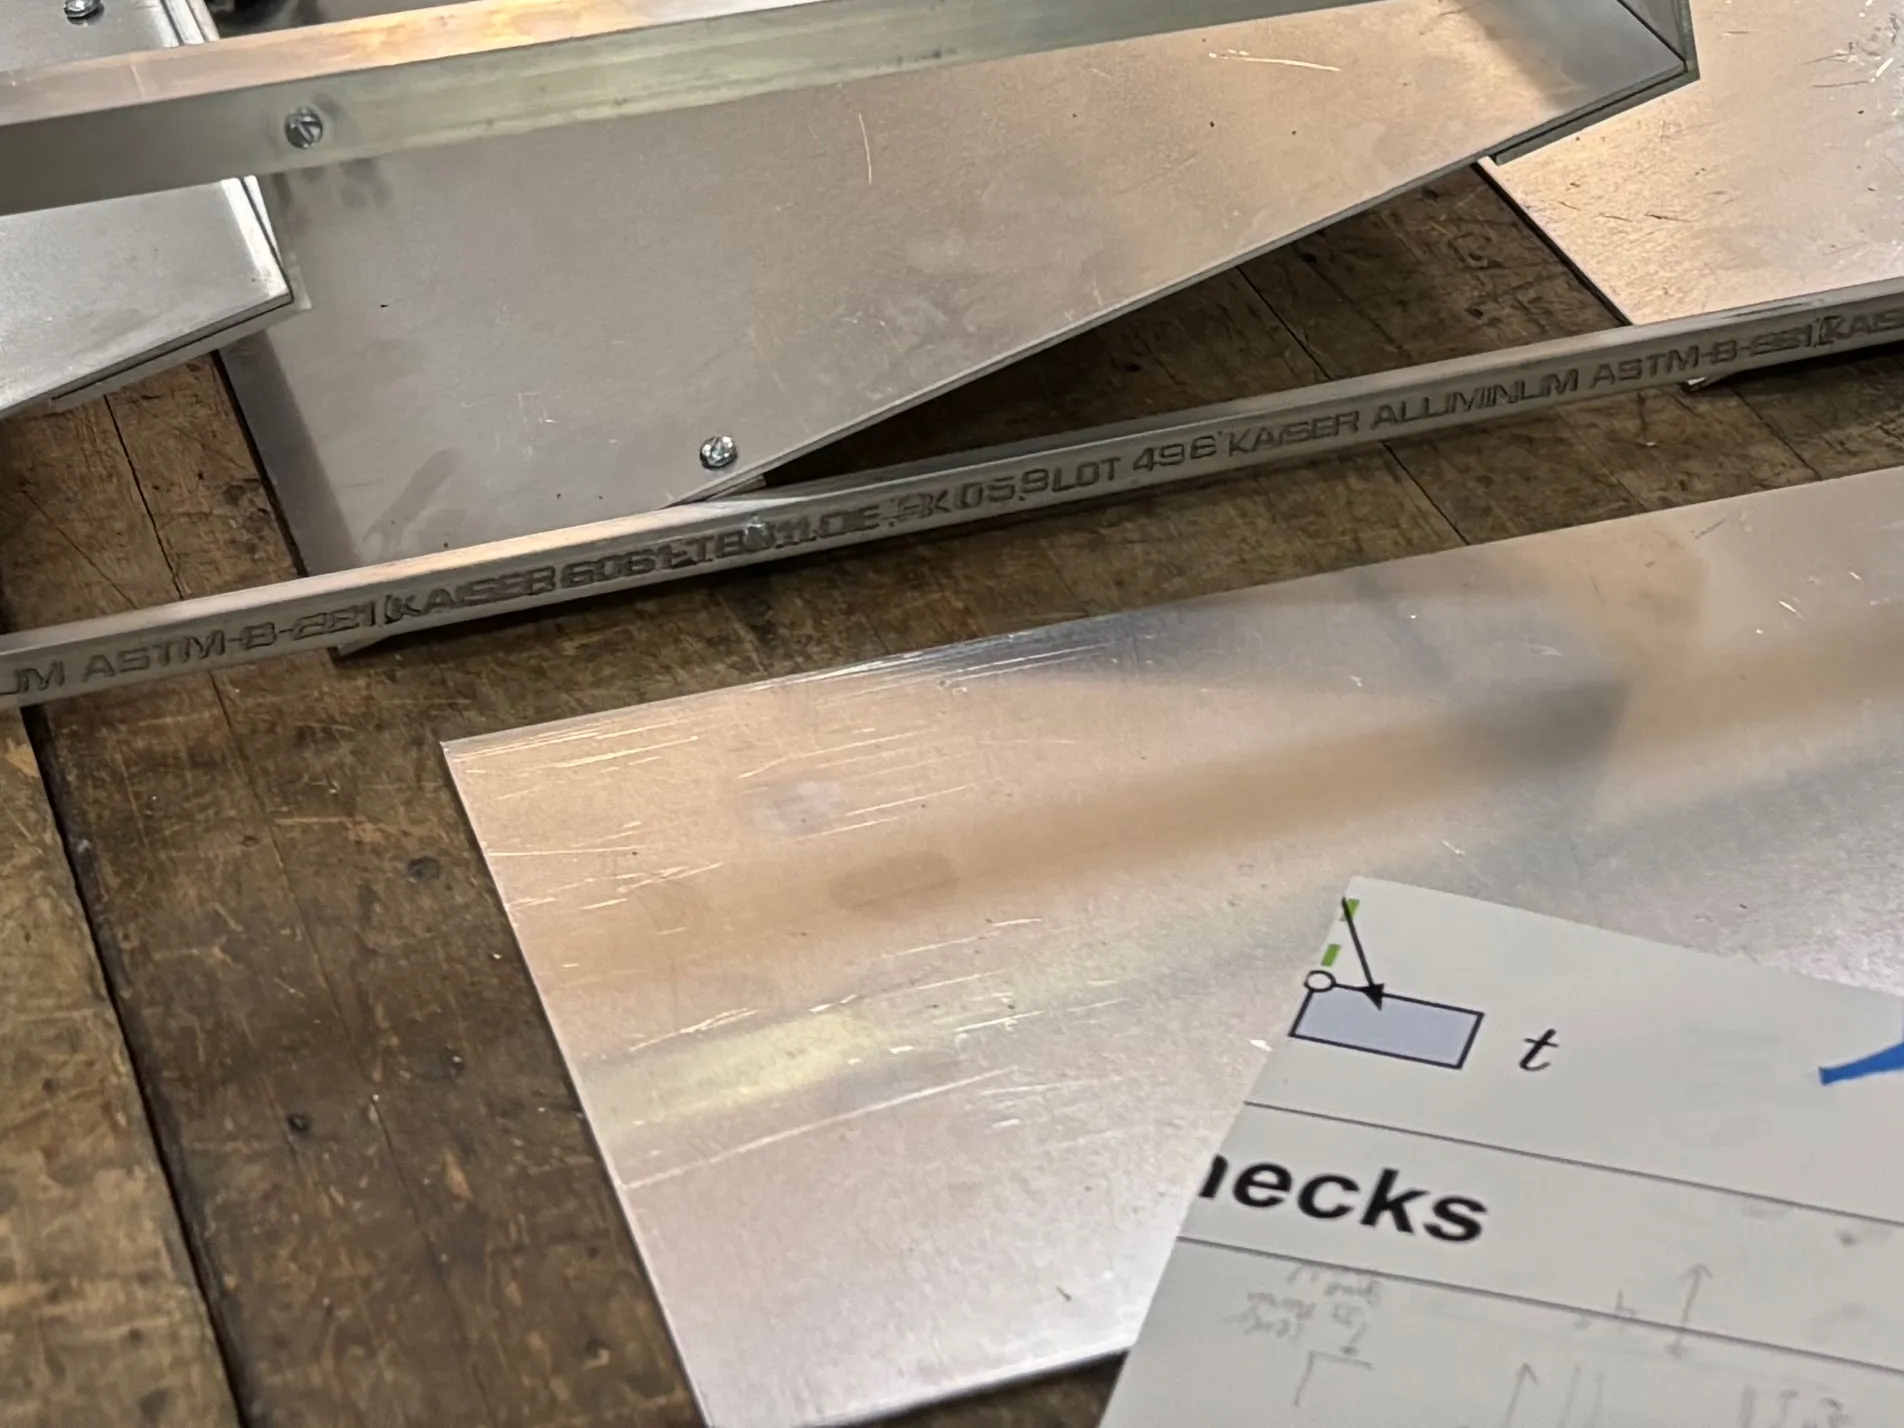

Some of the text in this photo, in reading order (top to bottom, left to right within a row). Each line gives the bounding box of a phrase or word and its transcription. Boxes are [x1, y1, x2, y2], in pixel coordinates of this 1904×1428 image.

[1132, 435, 1217, 473] 496
[1227, 411, 1360, 458] KAISER
[1370, 367, 1580, 431] ALUMINUM
[1518, 1027, 1560, 1073] t
